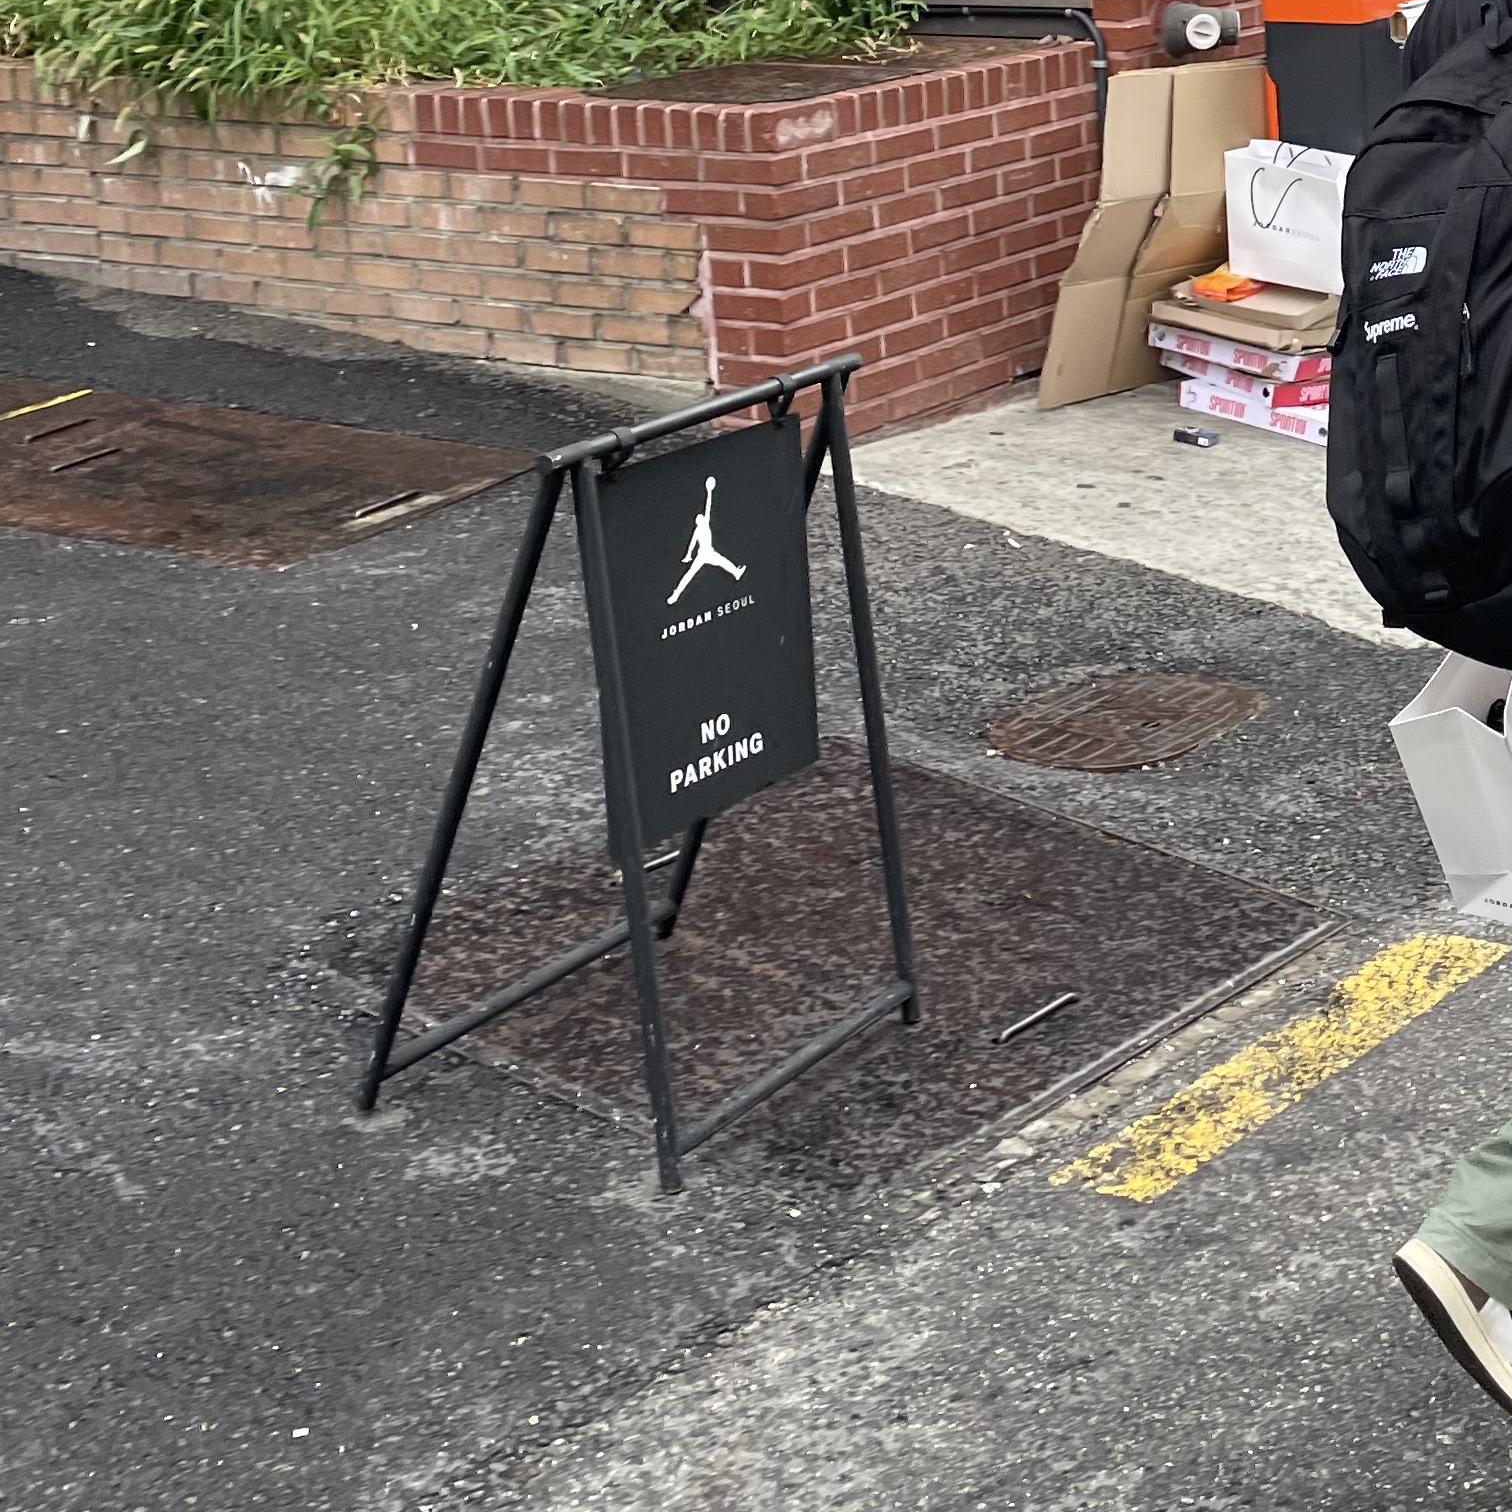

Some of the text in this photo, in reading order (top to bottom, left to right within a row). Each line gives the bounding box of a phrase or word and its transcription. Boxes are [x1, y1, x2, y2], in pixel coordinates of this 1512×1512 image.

[1369, 259, 1409, 274] NORTH
[1392, 247, 1415, 261] THE
[1363, 313, 1416, 344] Supreme
[661, 594, 755, 640] JORDAN SEOUL
[700, 713, 732, 744] NO
[669, 731, 765, 794] PARKING
